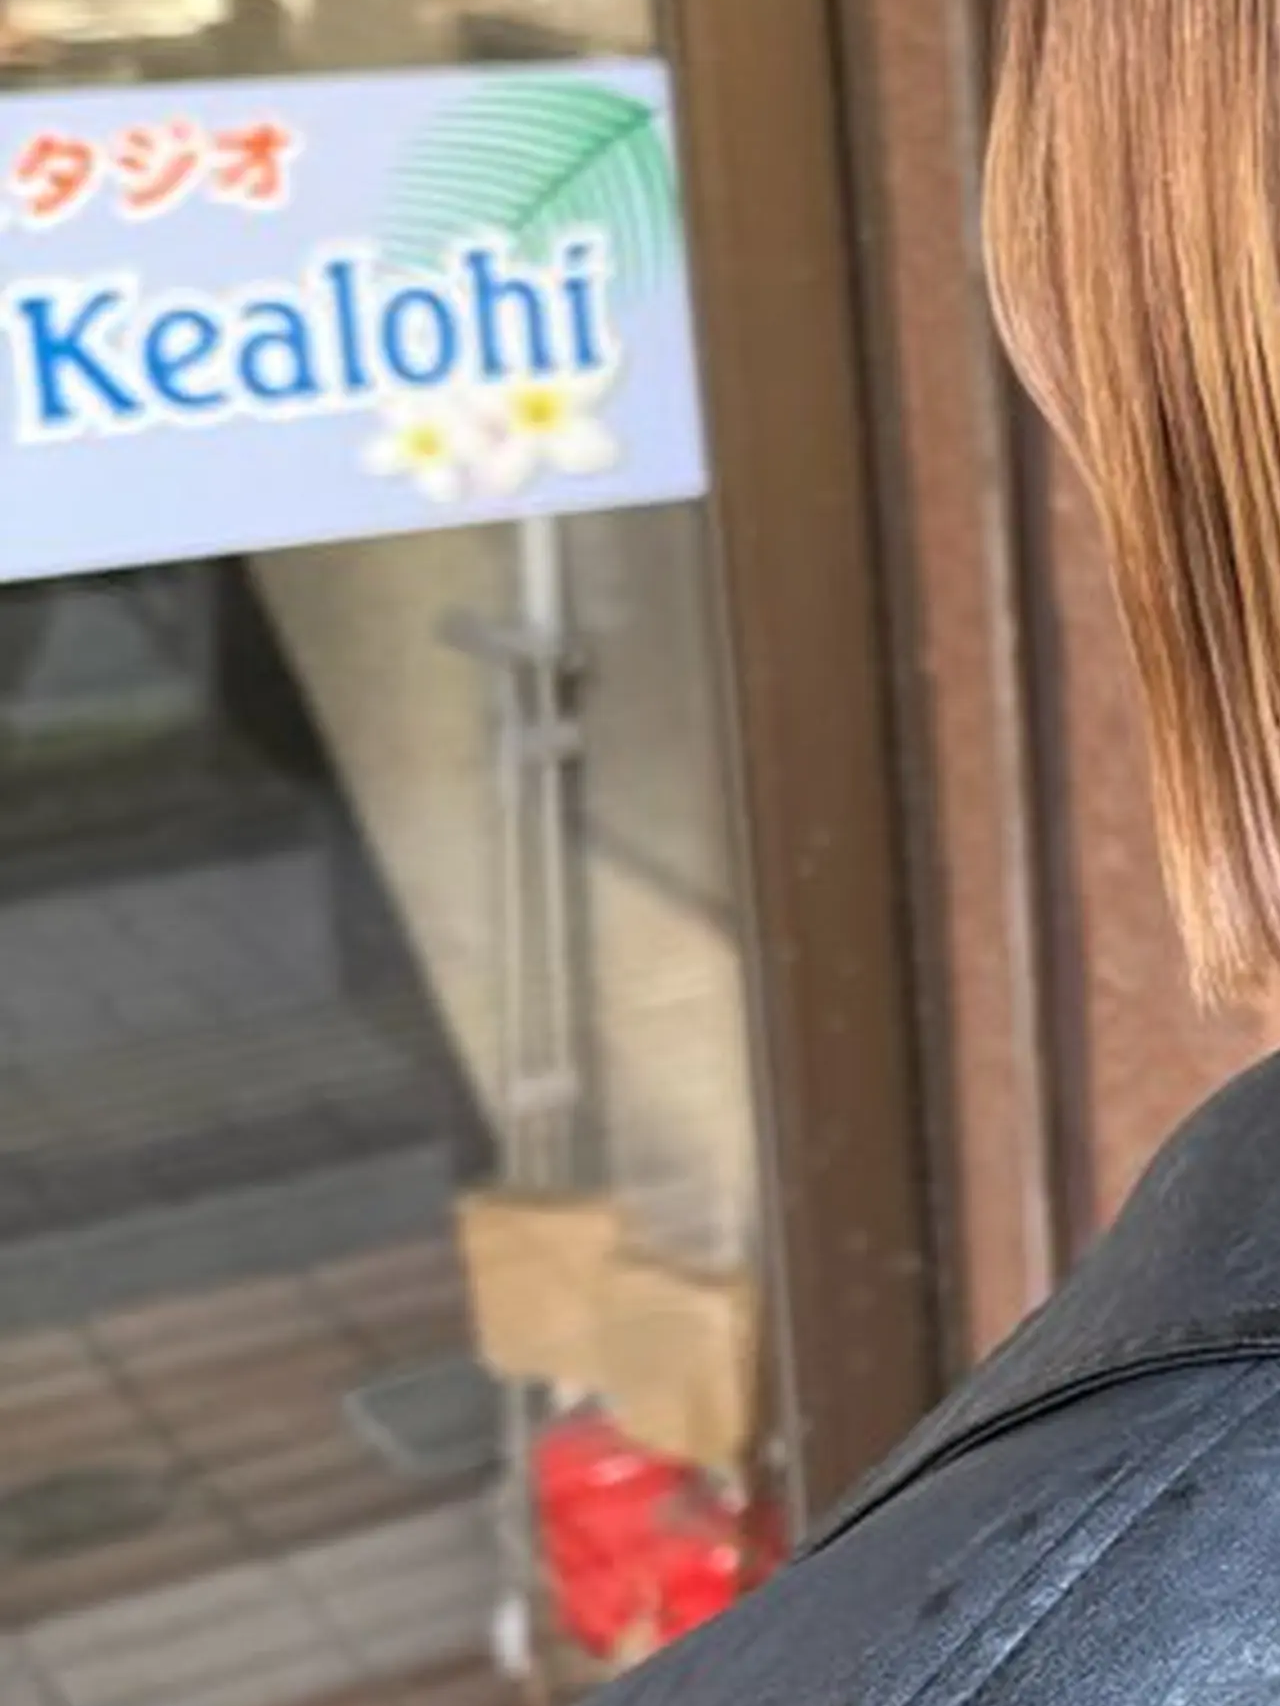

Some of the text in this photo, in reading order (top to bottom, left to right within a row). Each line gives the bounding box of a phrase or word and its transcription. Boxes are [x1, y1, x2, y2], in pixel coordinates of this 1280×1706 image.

[14, 119, 292, 219] タジオ
[18, 240, 604, 424] Kealohi
